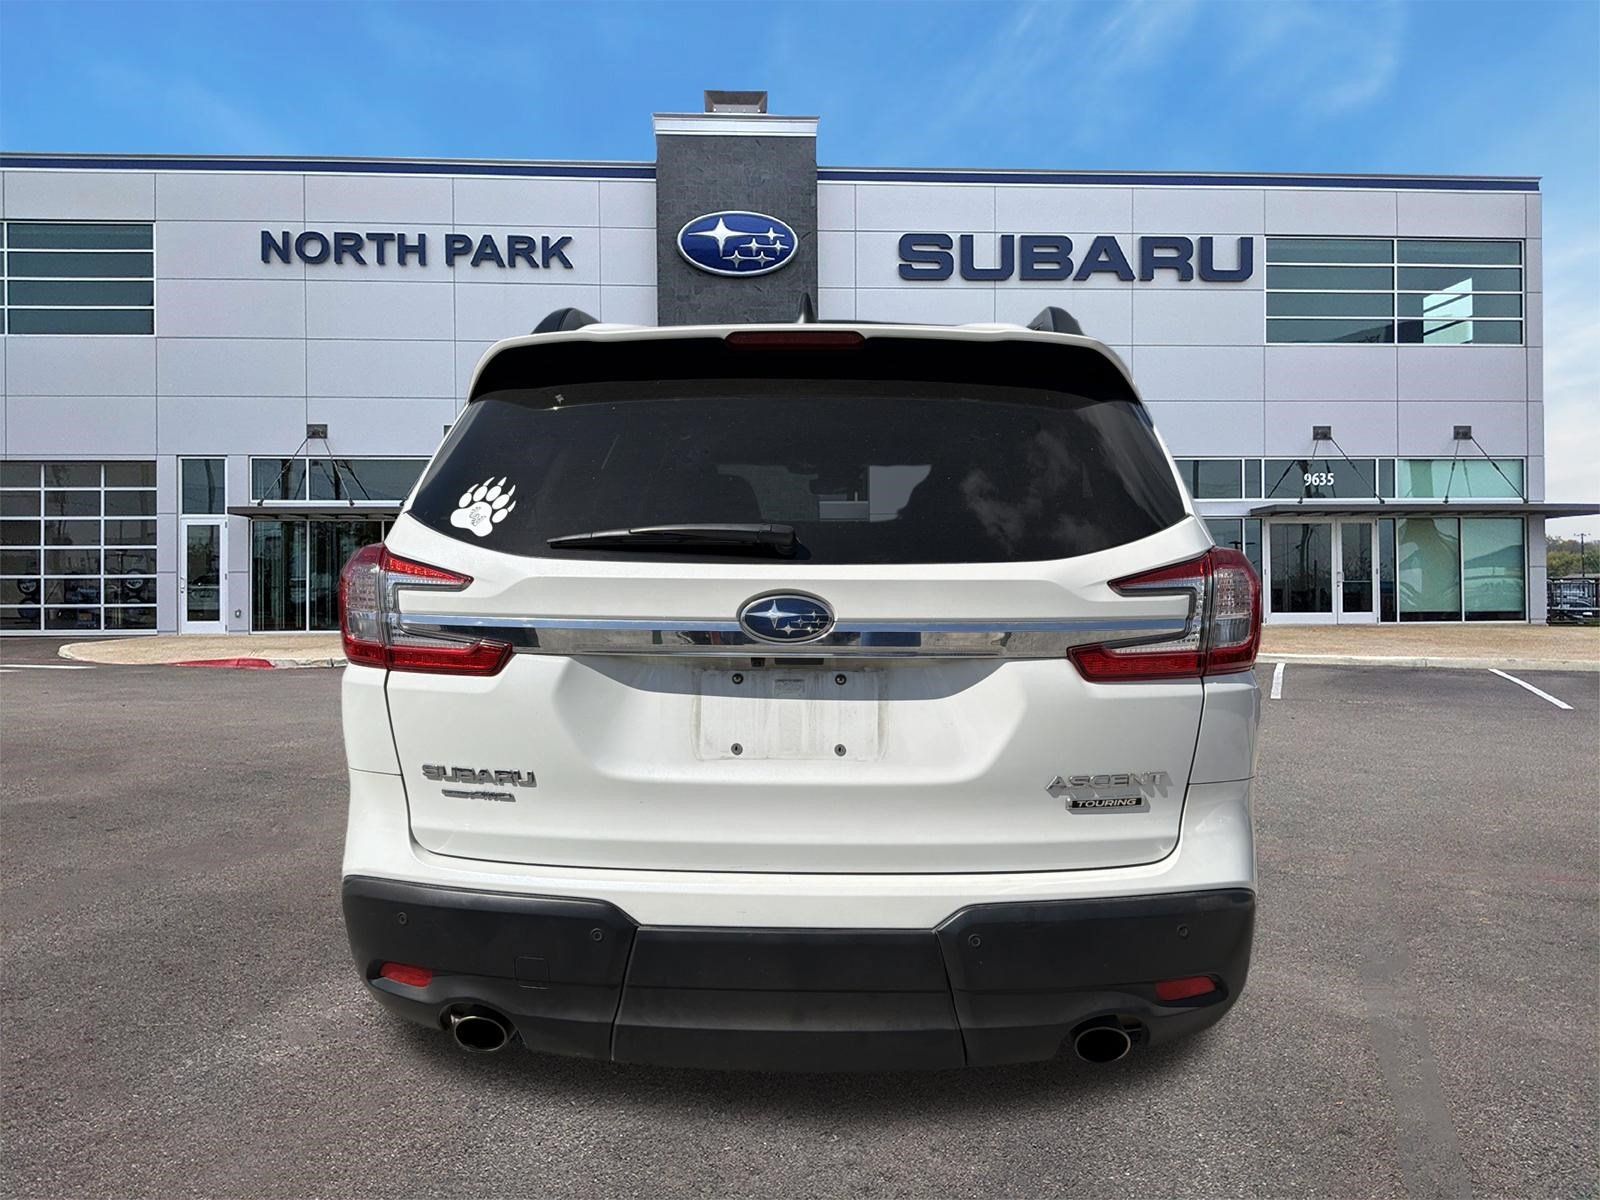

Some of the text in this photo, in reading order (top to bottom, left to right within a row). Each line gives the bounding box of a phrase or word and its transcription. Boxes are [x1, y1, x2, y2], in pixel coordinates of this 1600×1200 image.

[261, 230, 574, 269] NORTH PARK
[898, 233, 1254, 281] SUBARU
[1303, 472, 1335, 486] 9635
[422, 764, 537, 788] SUBARU
[1045, 771, 1170, 793] ASCENT
[1077, 798, 1138, 808] TOURING
